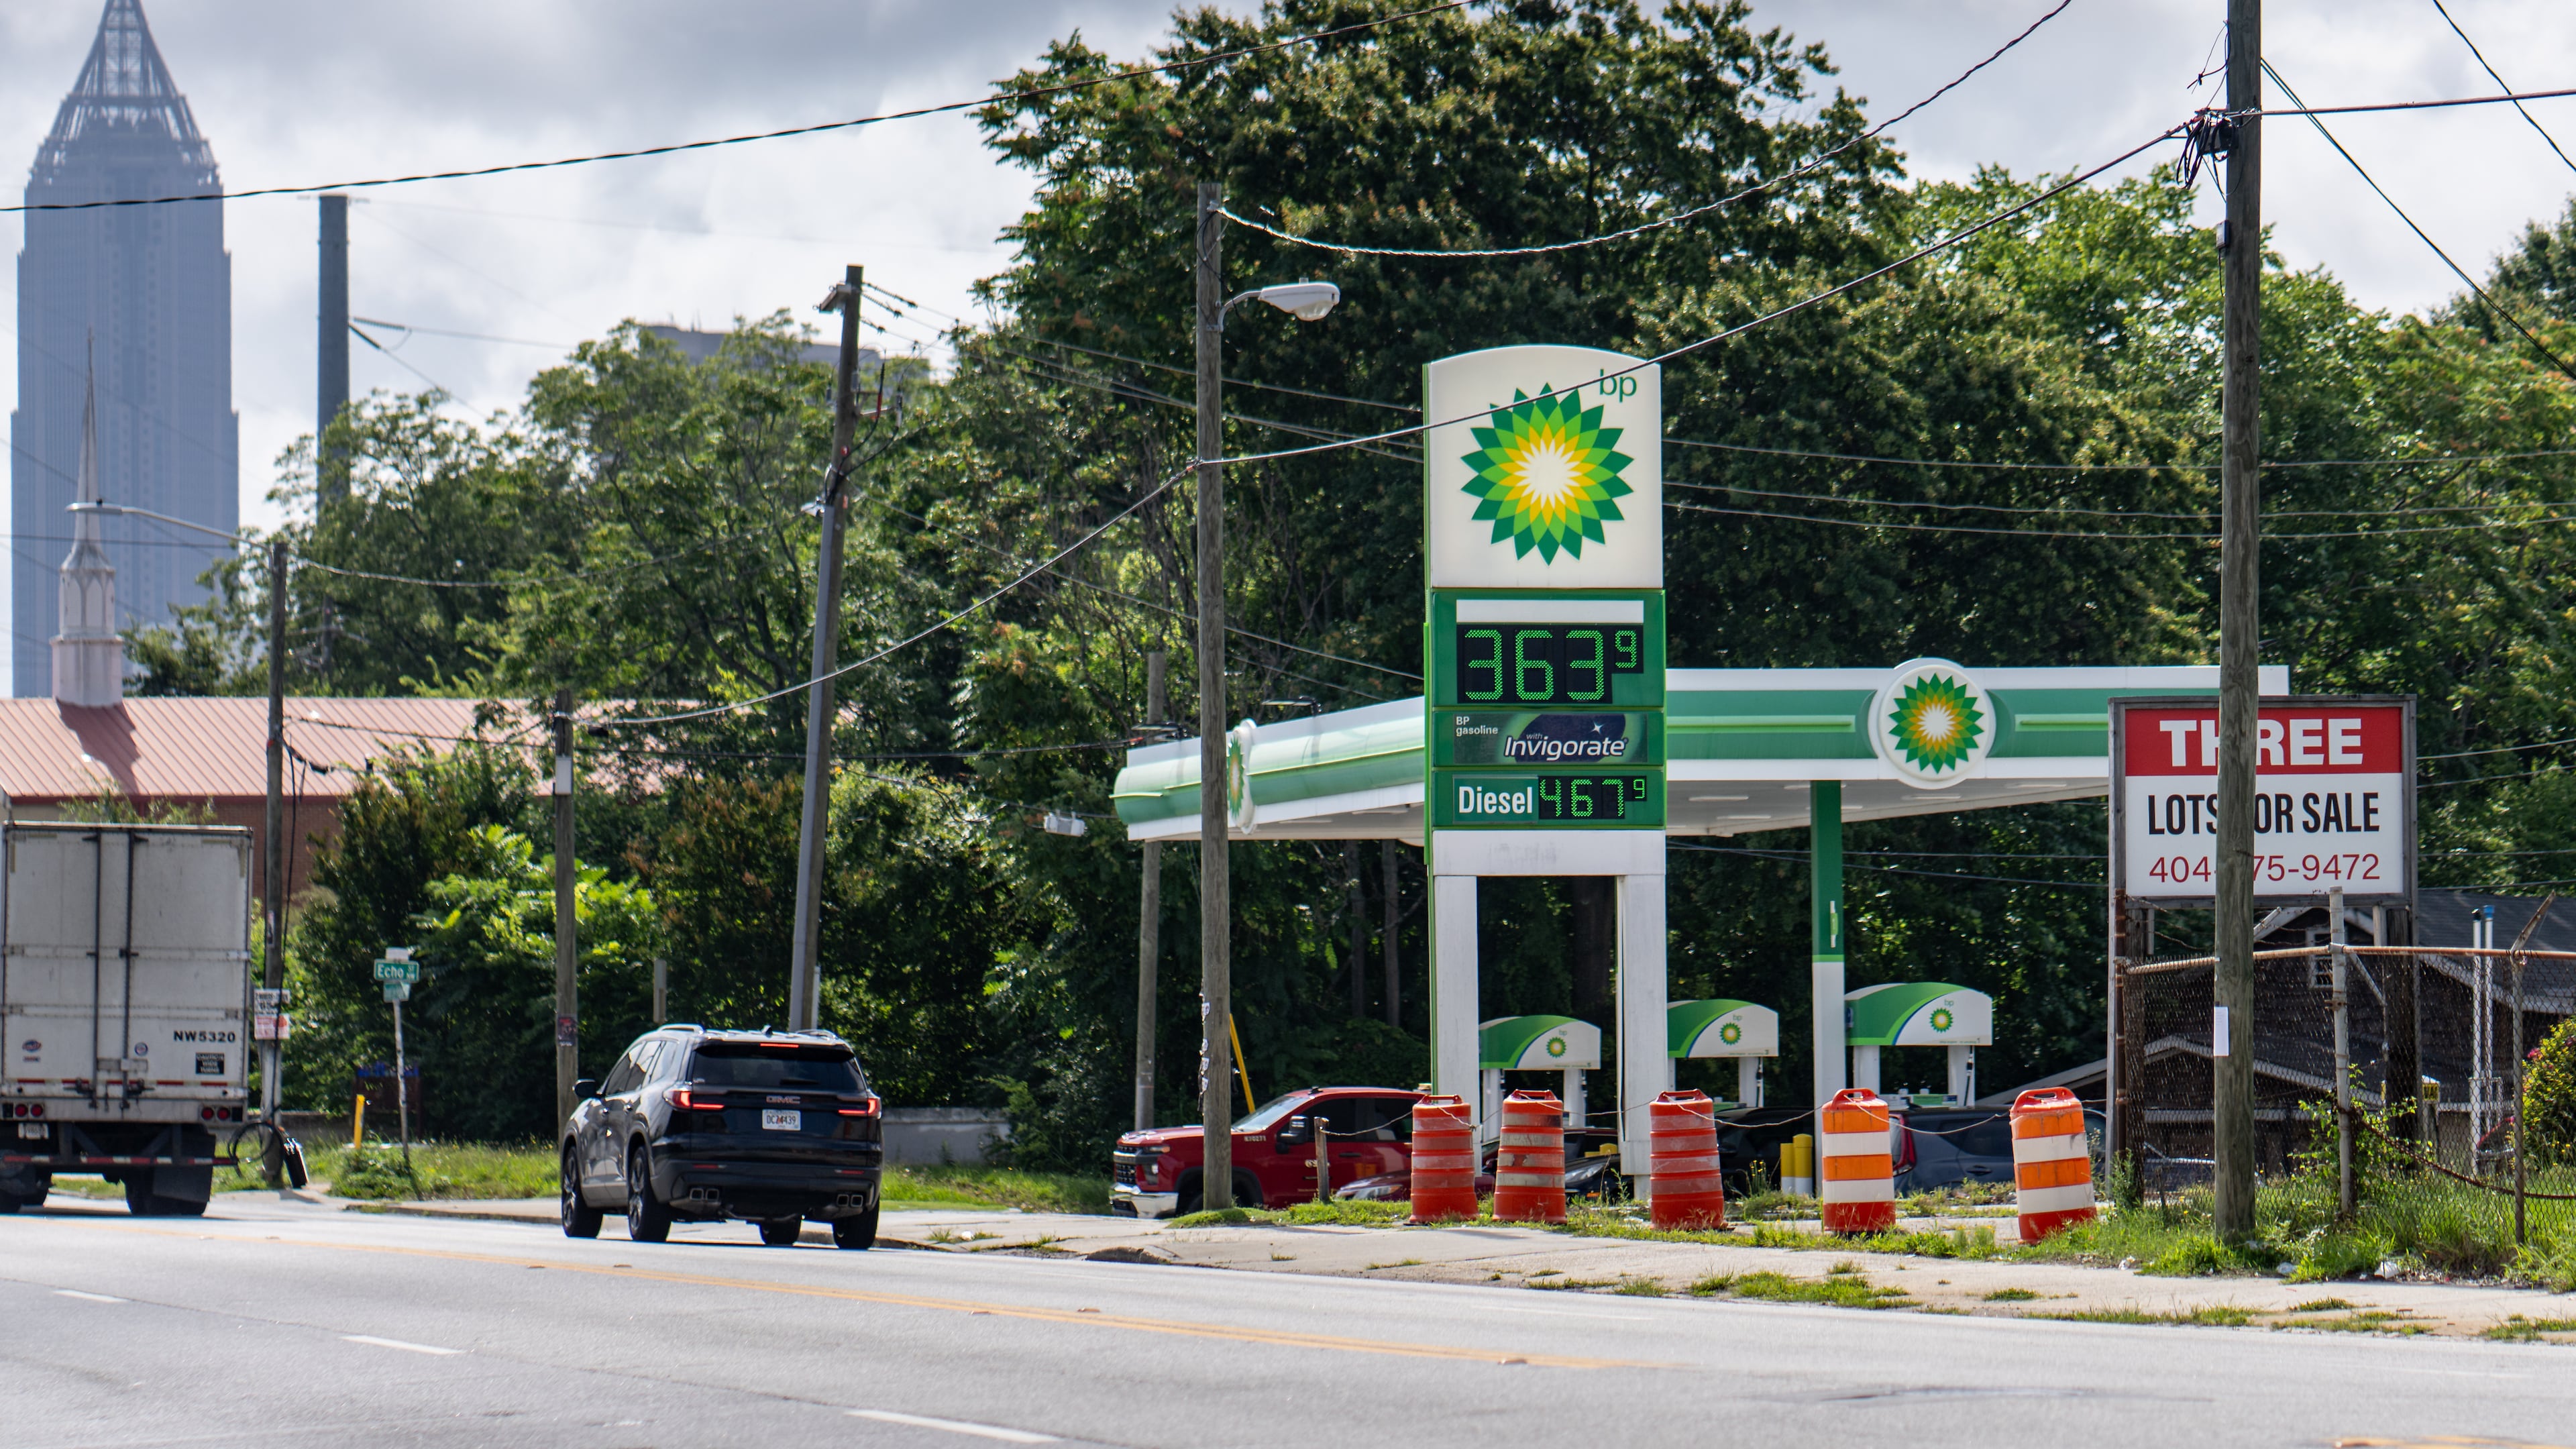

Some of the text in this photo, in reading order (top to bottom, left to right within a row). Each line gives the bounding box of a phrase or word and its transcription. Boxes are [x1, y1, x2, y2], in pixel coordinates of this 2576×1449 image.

[1600, 368, 1637, 402] bp
[1456, 716, 1470, 725] BP
[1456, 725, 1498, 737] gasoline
[1503, 736, 1625, 761] Invigorate
[1458, 786, 1533, 814] Diesel
[2253, 793, 2294, 834] OR
[2302, 792, 2380, 833] SALE
[378, 964, 404, 979] Echo
[174, 1030, 235, 1042] NW5320
[766, 1095, 800, 1104] GMC
